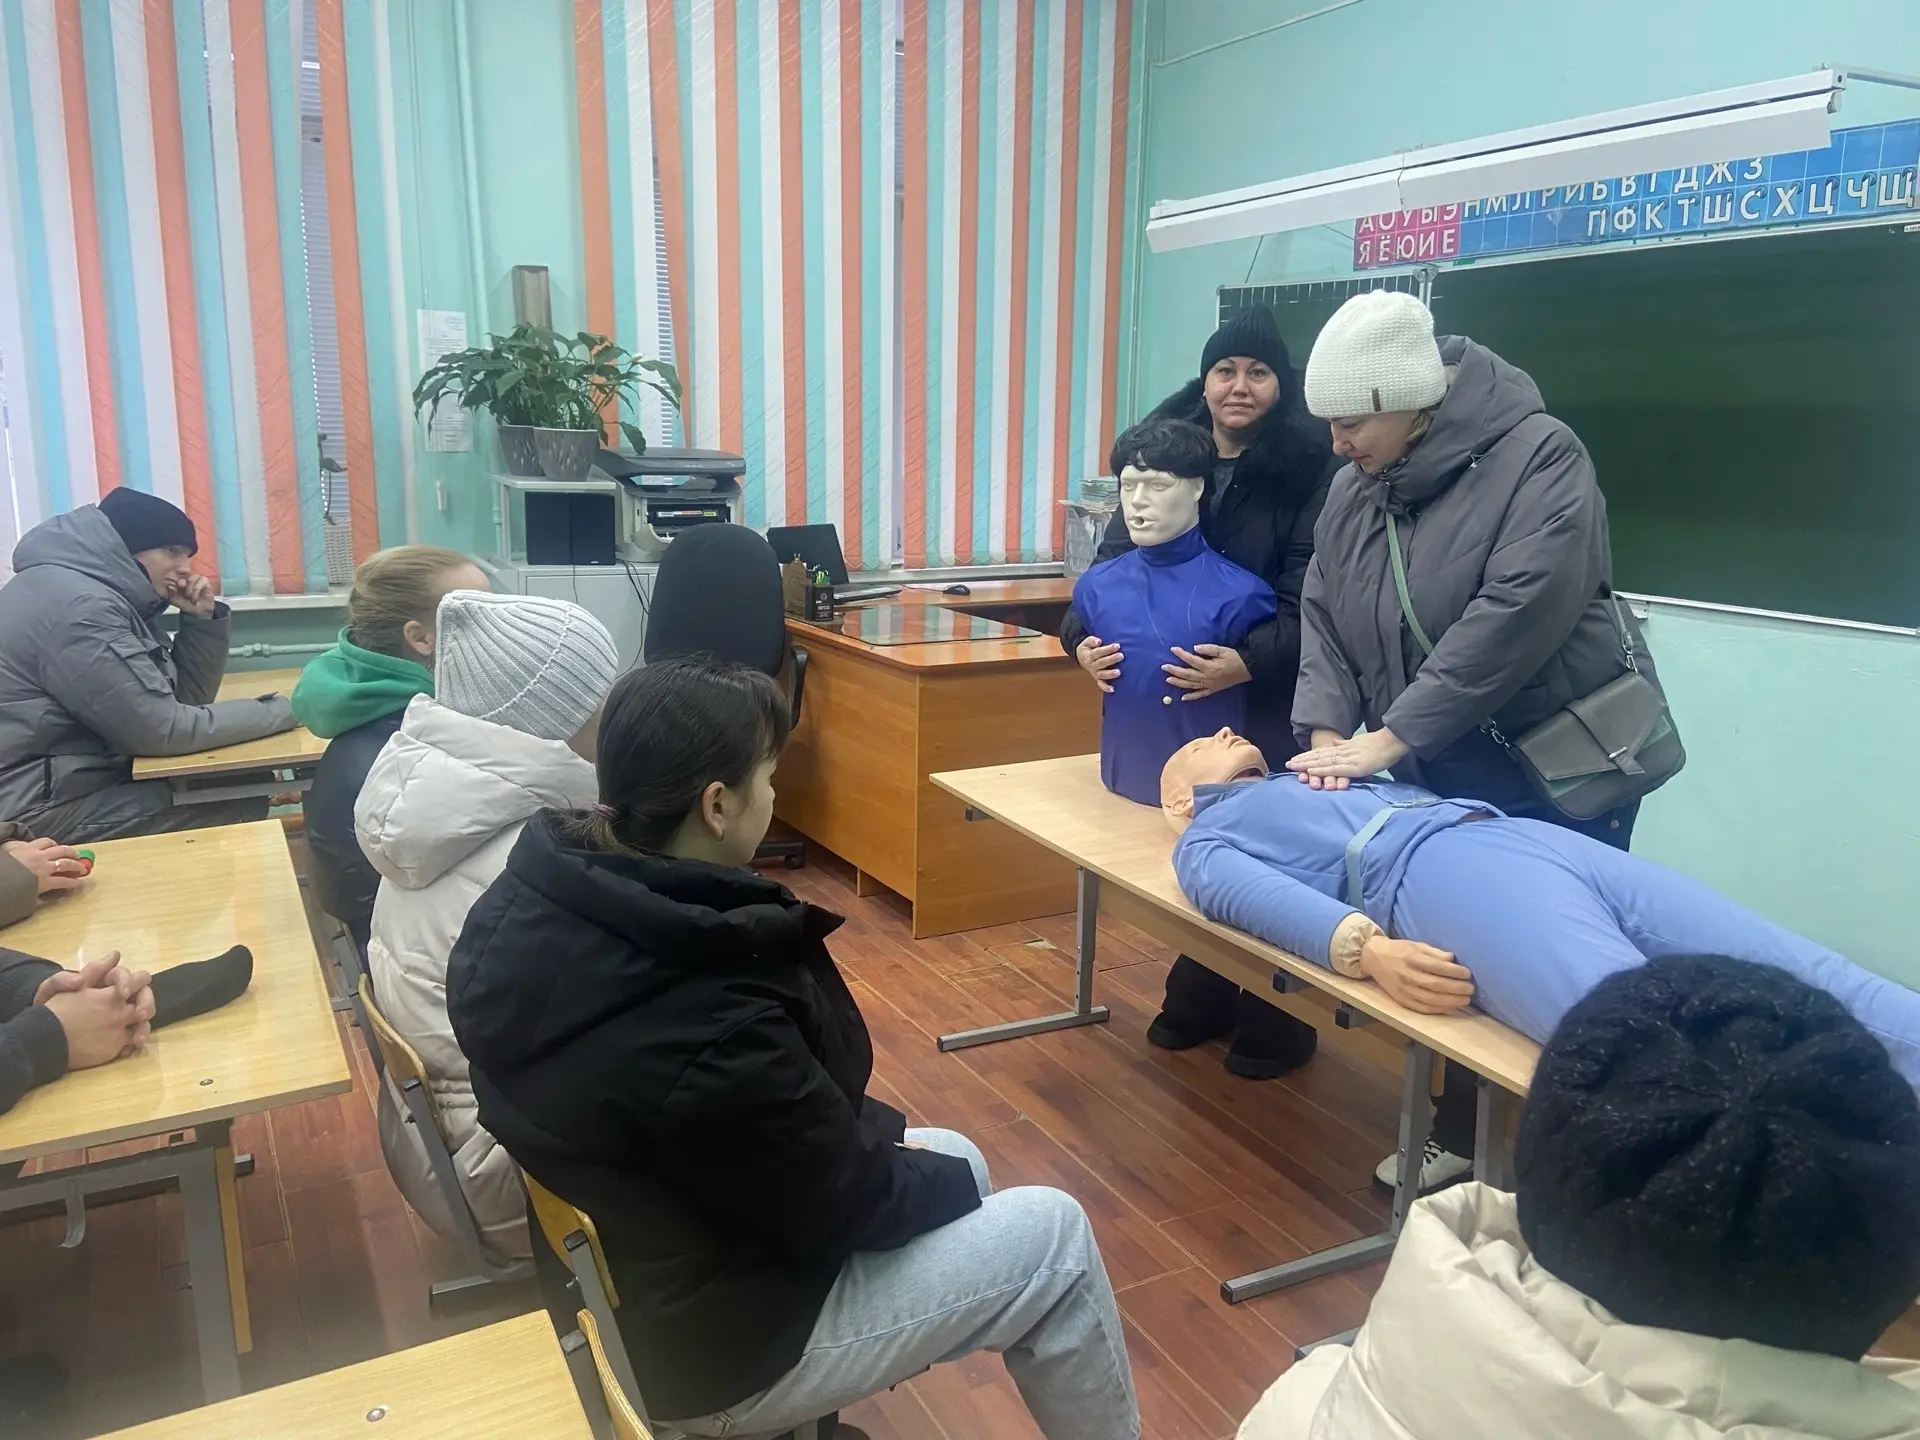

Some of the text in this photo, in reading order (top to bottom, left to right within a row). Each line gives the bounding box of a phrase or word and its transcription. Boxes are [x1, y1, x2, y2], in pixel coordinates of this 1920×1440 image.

[1358, 240, 1371, 264] Я
[1396, 235, 1416, 261] Ю
[1418, 231, 1435, 258] И
[1442, 228, 1456, 254] Е
[1587, 208, 1607, 237] П
[1613, 206, 1637, 233] Ф
[1645, 201, 1665, 231] К
[1677, 198, 1697, 227] Т
[1702, 192, 1732, 224] Ш
[1740, 188, 1760, 220] С
[1772, 185, 1798, 217] Х
[1808, 181, 1833, 215] Ц
[1847, 177, 1870, 209] Ч
[1878, 171, 1915, 209] Щ
[1421, 206, 1438, 224] Ы
[1485, 196, 1507, 215] М
[1673, 166, 1699, 194] Д
[1705, 161, 1734, 186] Ж
[1743, 157, 1763, 180] З
